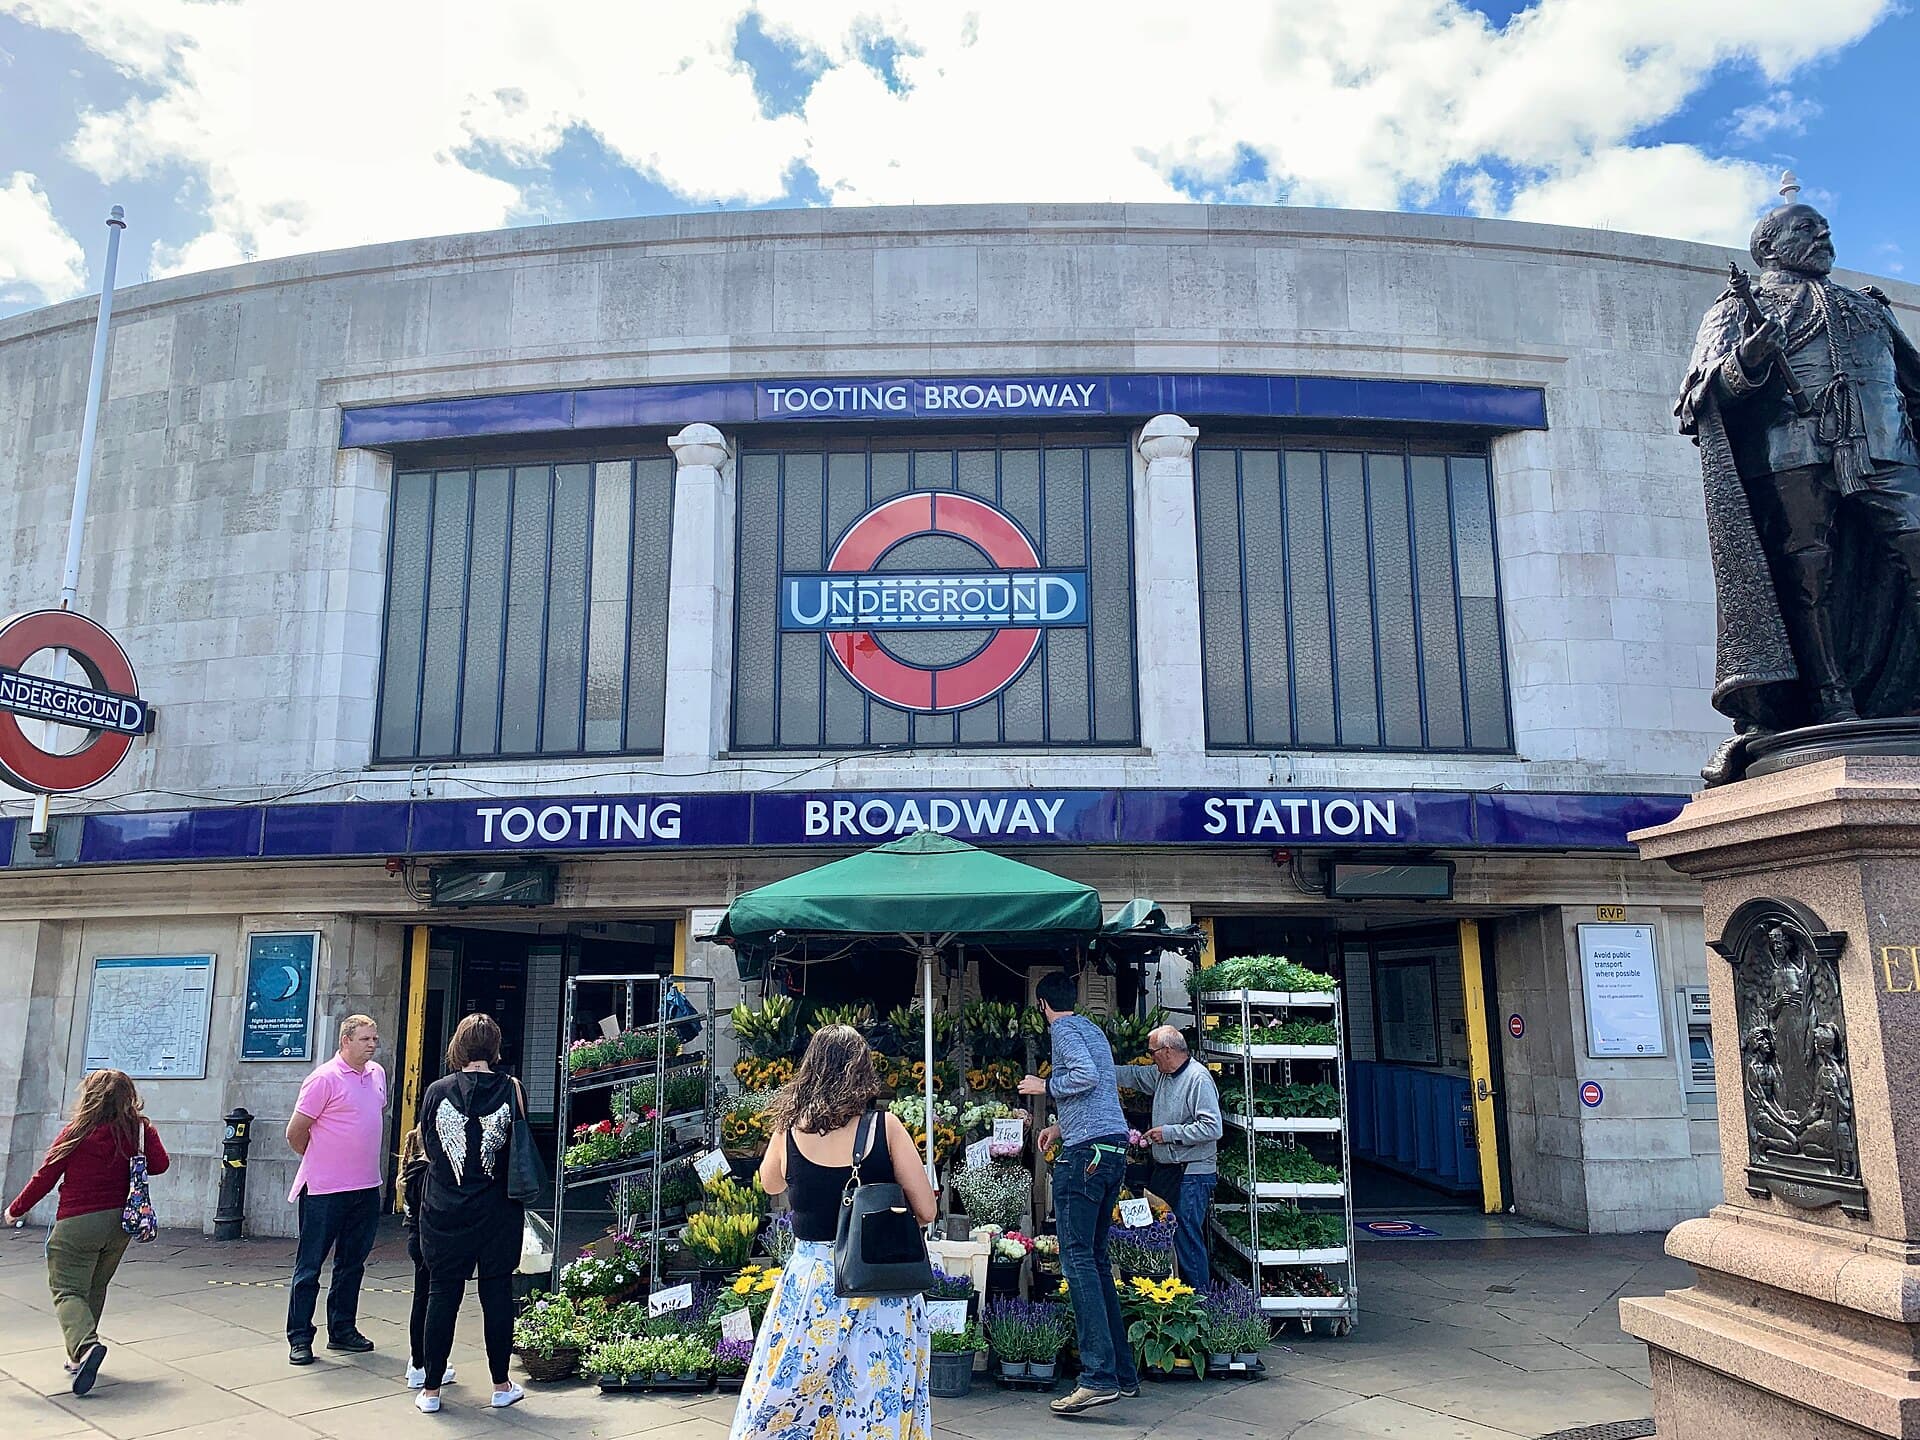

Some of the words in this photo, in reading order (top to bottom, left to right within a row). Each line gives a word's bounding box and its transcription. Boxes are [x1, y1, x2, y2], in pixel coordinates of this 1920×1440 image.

[768, 387, 906, 411] TOOTING
[925, 383, 1096, 409] BROADWAY
[791, 577, 1077, 624] UNDERGROUND
[477, 803, 681, 843] TOOTING
[805, 798, 1065, 836] BROADWAY
[1204, 797, 1397, 835] STATION
[1600, 908, 1623, 919] RVP
[1612, 952, 1631, 960] public
[1595, 961, 1623, 969] transport
[1595, 970, 1615, 978] where
[1616, 970, 1641, 978] possible
